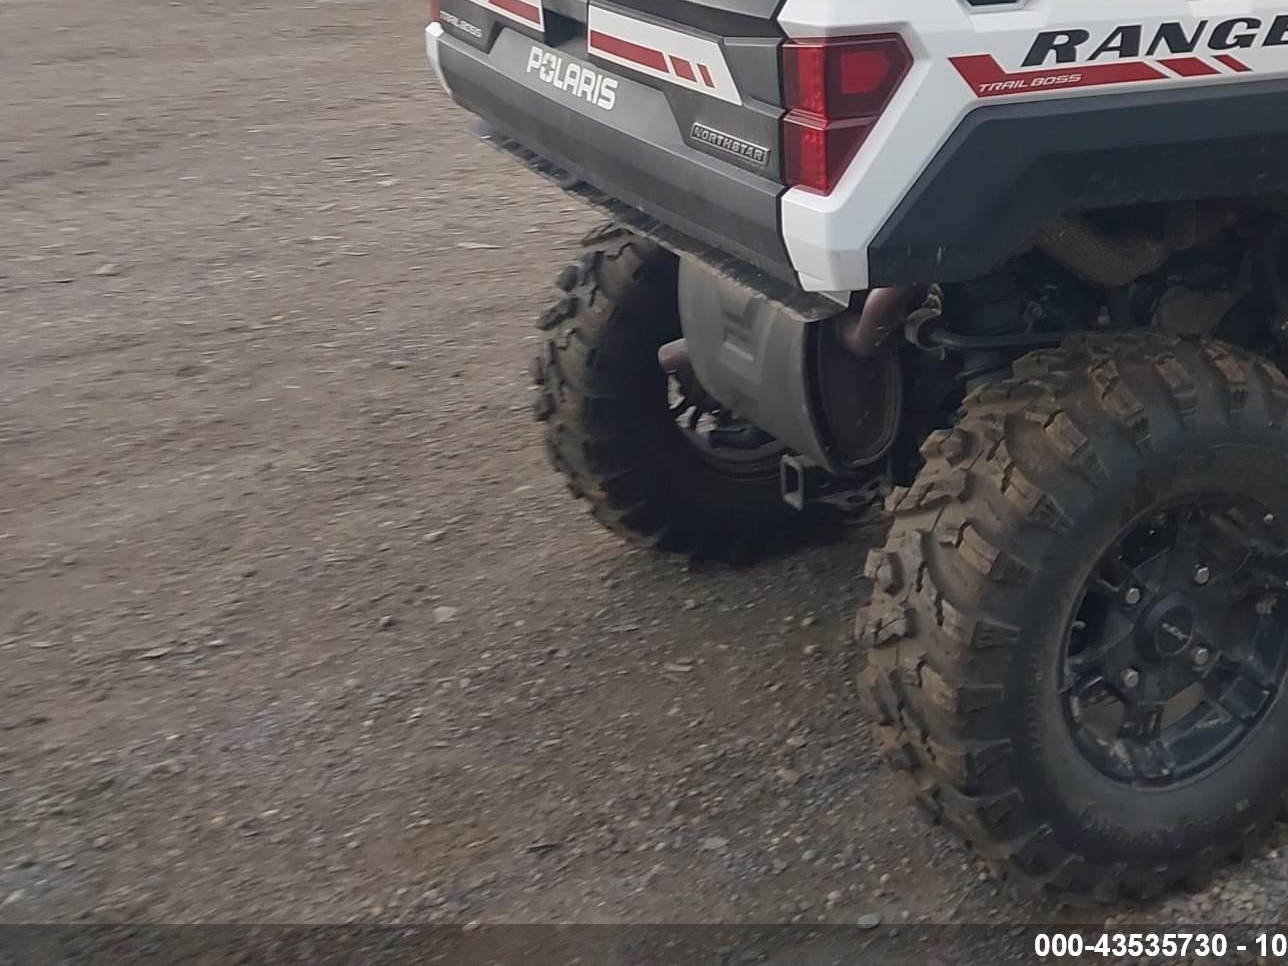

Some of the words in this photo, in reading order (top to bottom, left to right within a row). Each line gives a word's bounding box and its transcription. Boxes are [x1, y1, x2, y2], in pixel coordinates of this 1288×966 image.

[526, 45, 619, 111] POLARIS
[979, 79, 1028, 93] TRAIL
[1030, 73, 1083, 87] BOSS
[693, 124, 766, 163] NORTHSTAR
